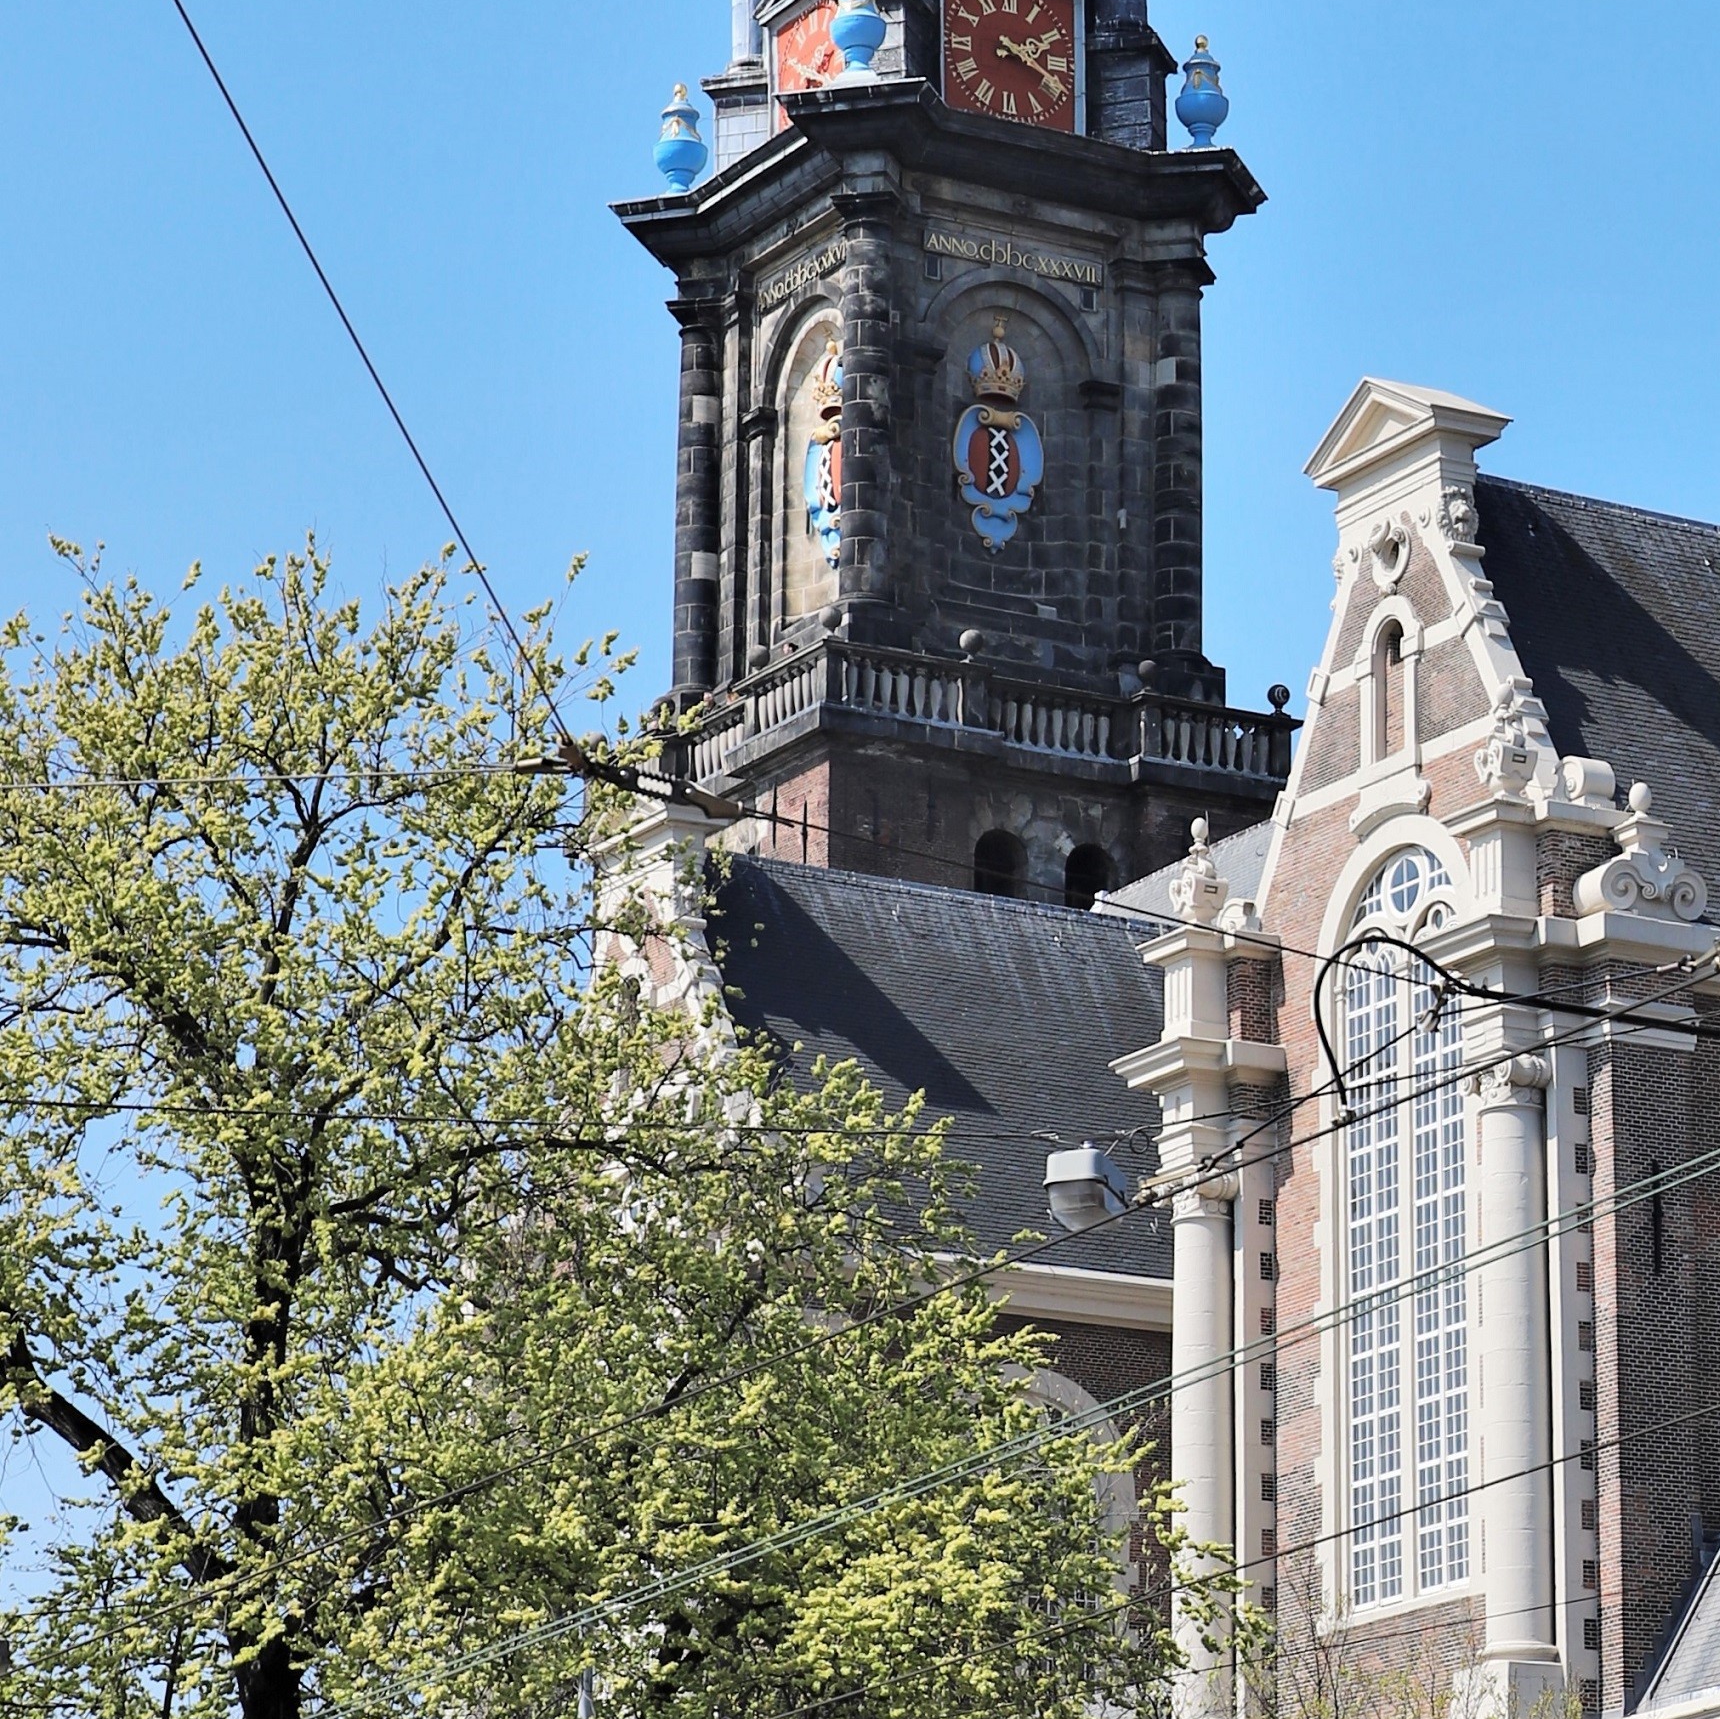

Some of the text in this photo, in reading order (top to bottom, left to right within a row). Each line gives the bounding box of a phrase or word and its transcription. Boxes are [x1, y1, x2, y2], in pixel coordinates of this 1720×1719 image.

[958, 6, 980, 27] X
[1040, 28, 1061, 46] II
[956, 57, 979, 81] VIII
[1047, 54, 1067, 73] III
[974, 78, 995, 105] VII
[1002, 91, 1017, 115] VI
[1028, 92, 1043, 114] V
